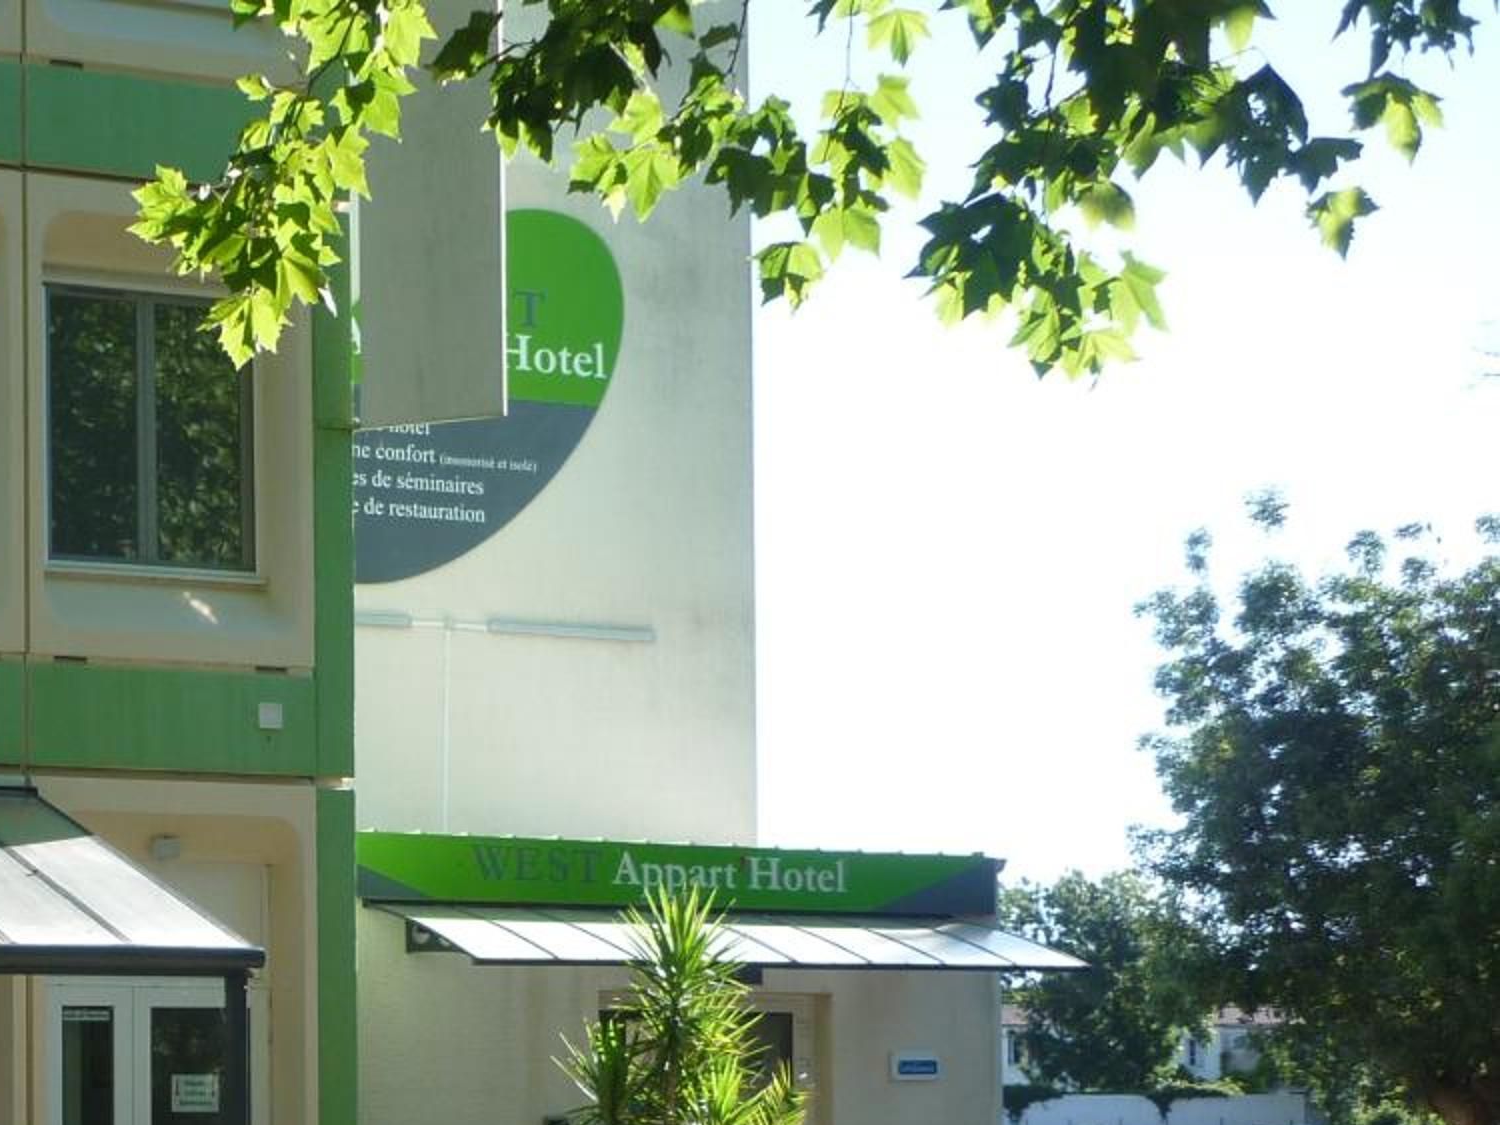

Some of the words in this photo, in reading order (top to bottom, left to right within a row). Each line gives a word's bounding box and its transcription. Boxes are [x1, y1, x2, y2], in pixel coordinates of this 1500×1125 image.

[506, 333, 607, 379] Hotel
[375, 444, 436, 464] confort
[372, 469, 392, 489] de
[396, 472, 485, 496] séminaires
[363, 497, 385, 516] de
[389, 502, 486, 524] restauration
[474, 847, 602, 881] WEST
[611, 851, 738, 900] Appart
[746, 856, 848, 893] Hotel
